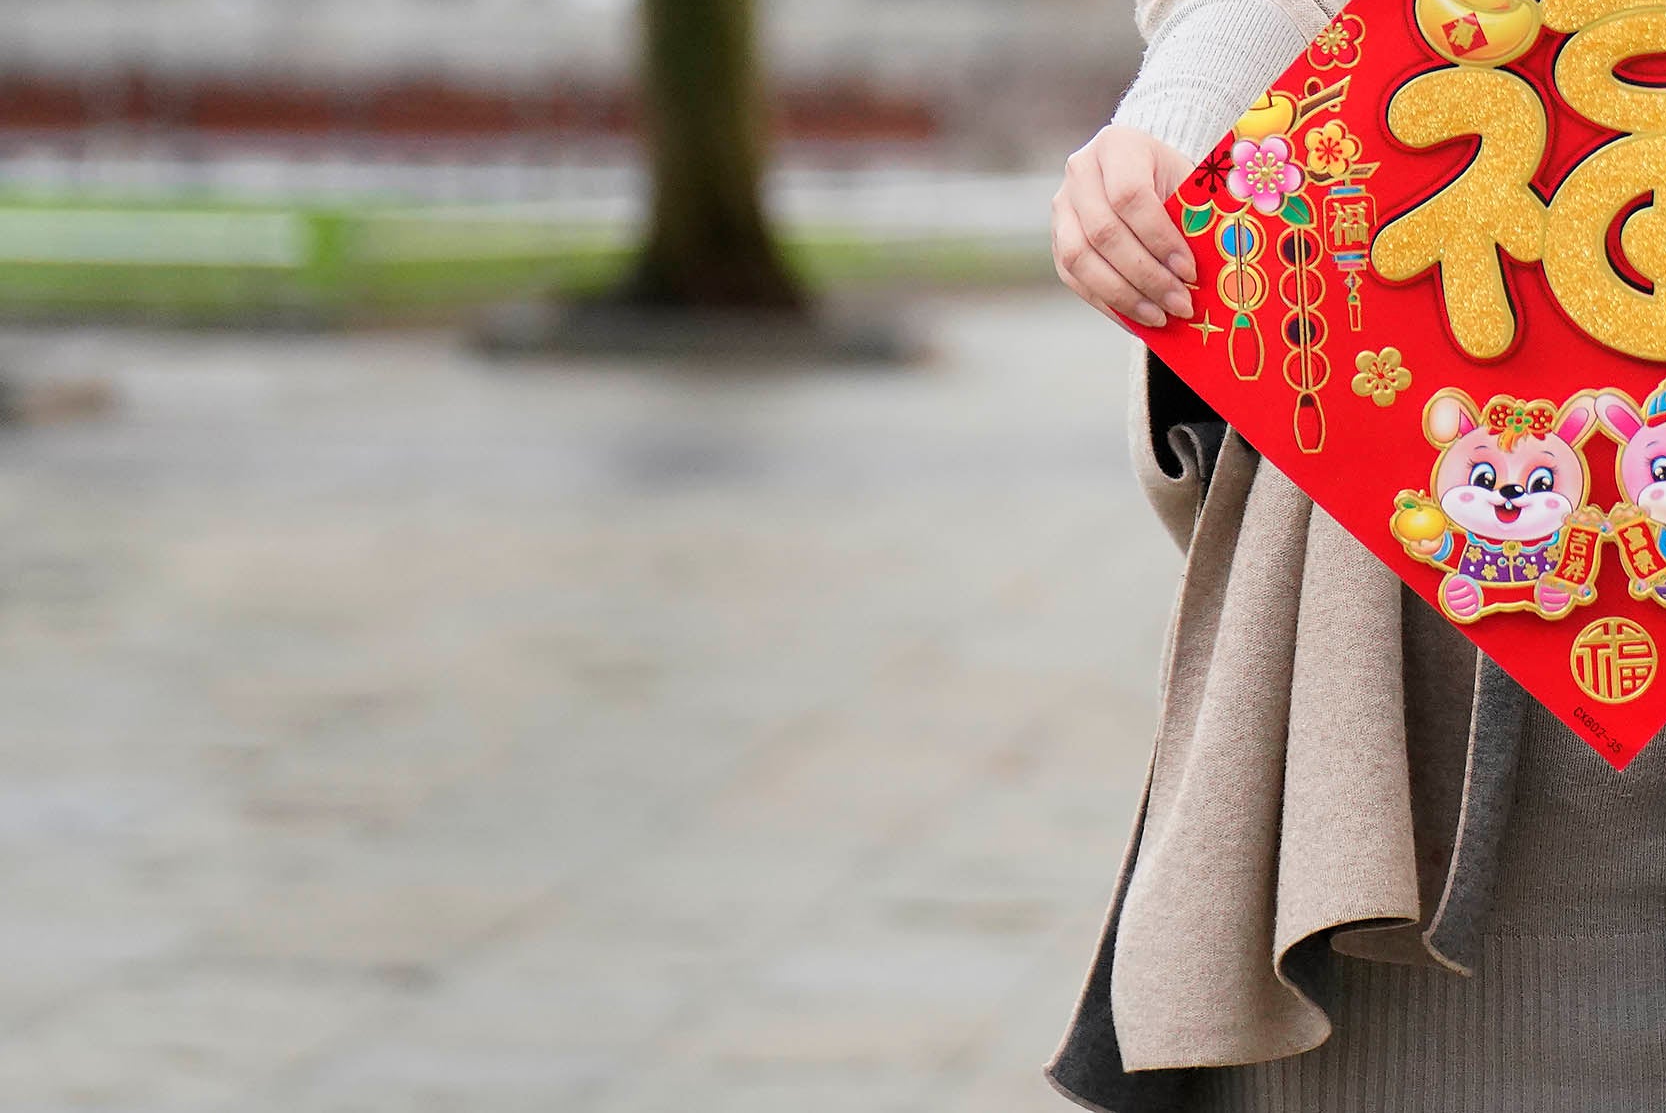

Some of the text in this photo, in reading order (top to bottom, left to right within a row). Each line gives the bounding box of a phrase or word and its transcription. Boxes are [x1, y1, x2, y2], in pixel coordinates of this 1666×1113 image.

[1329, 201, 1369, 246] 福
[1561, 531, 1592, 581] 吉祥
[1571, 616, 1658, 703] 福
